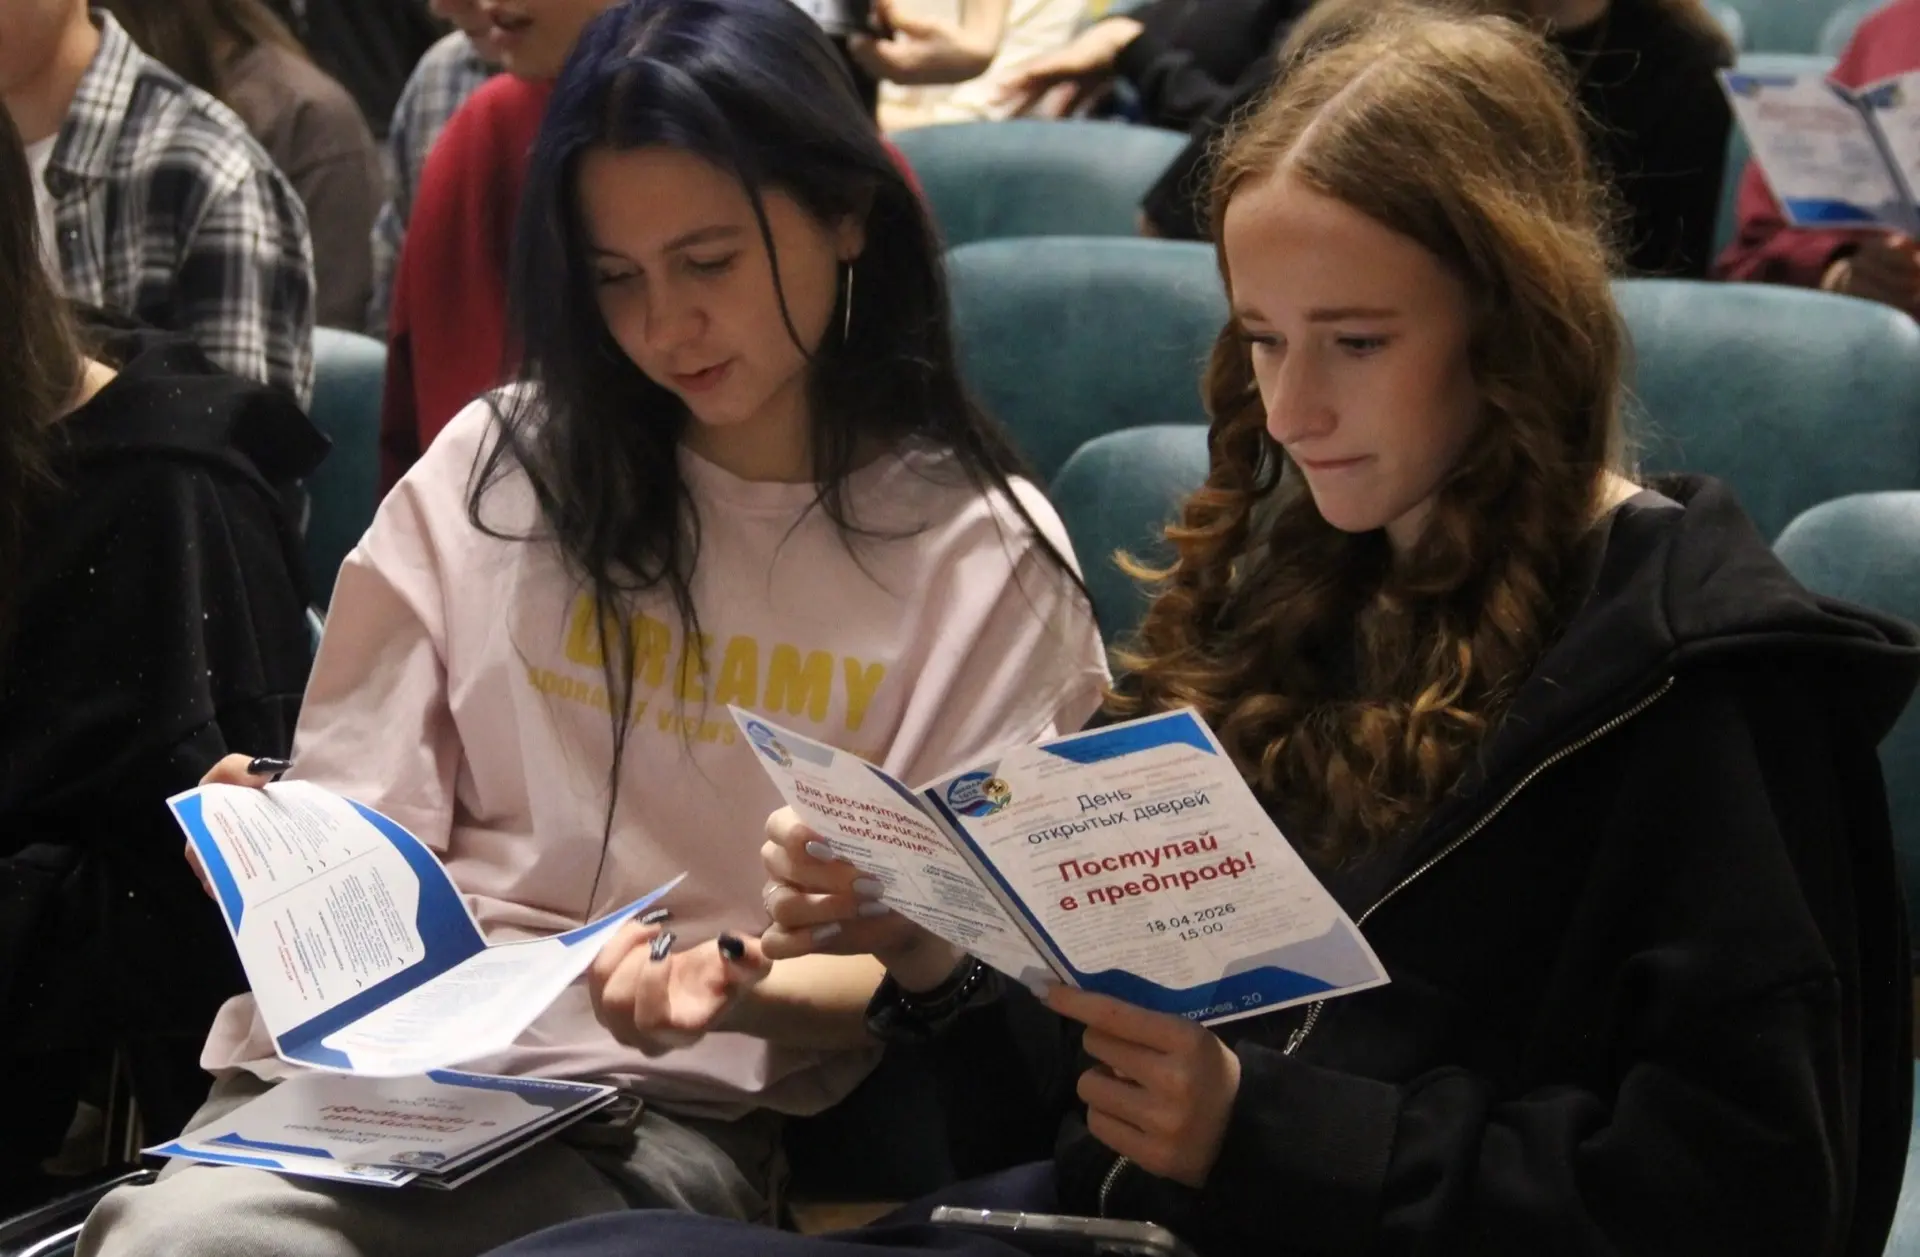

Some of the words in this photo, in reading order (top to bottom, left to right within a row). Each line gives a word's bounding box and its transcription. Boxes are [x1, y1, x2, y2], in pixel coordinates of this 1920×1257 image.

[564, 593, 885, 732] DREAMY
[795, 780, 823, 799] Для
[1076, 788, 1133, 812] День
[859, 816, 870, 826] о
[1027, 811, 1129, 846] открытых
[1133, 789, 1211, 822] дверей
[838, 823, 939, 858] необходимо:
[1058, 831, 1219, 882] Поступай
[1086, 851, 1257, 906] предпроф!
[1146, 902, 1237, 934] 18.04.2026
[1242, 991, 1263, 1007] 20
